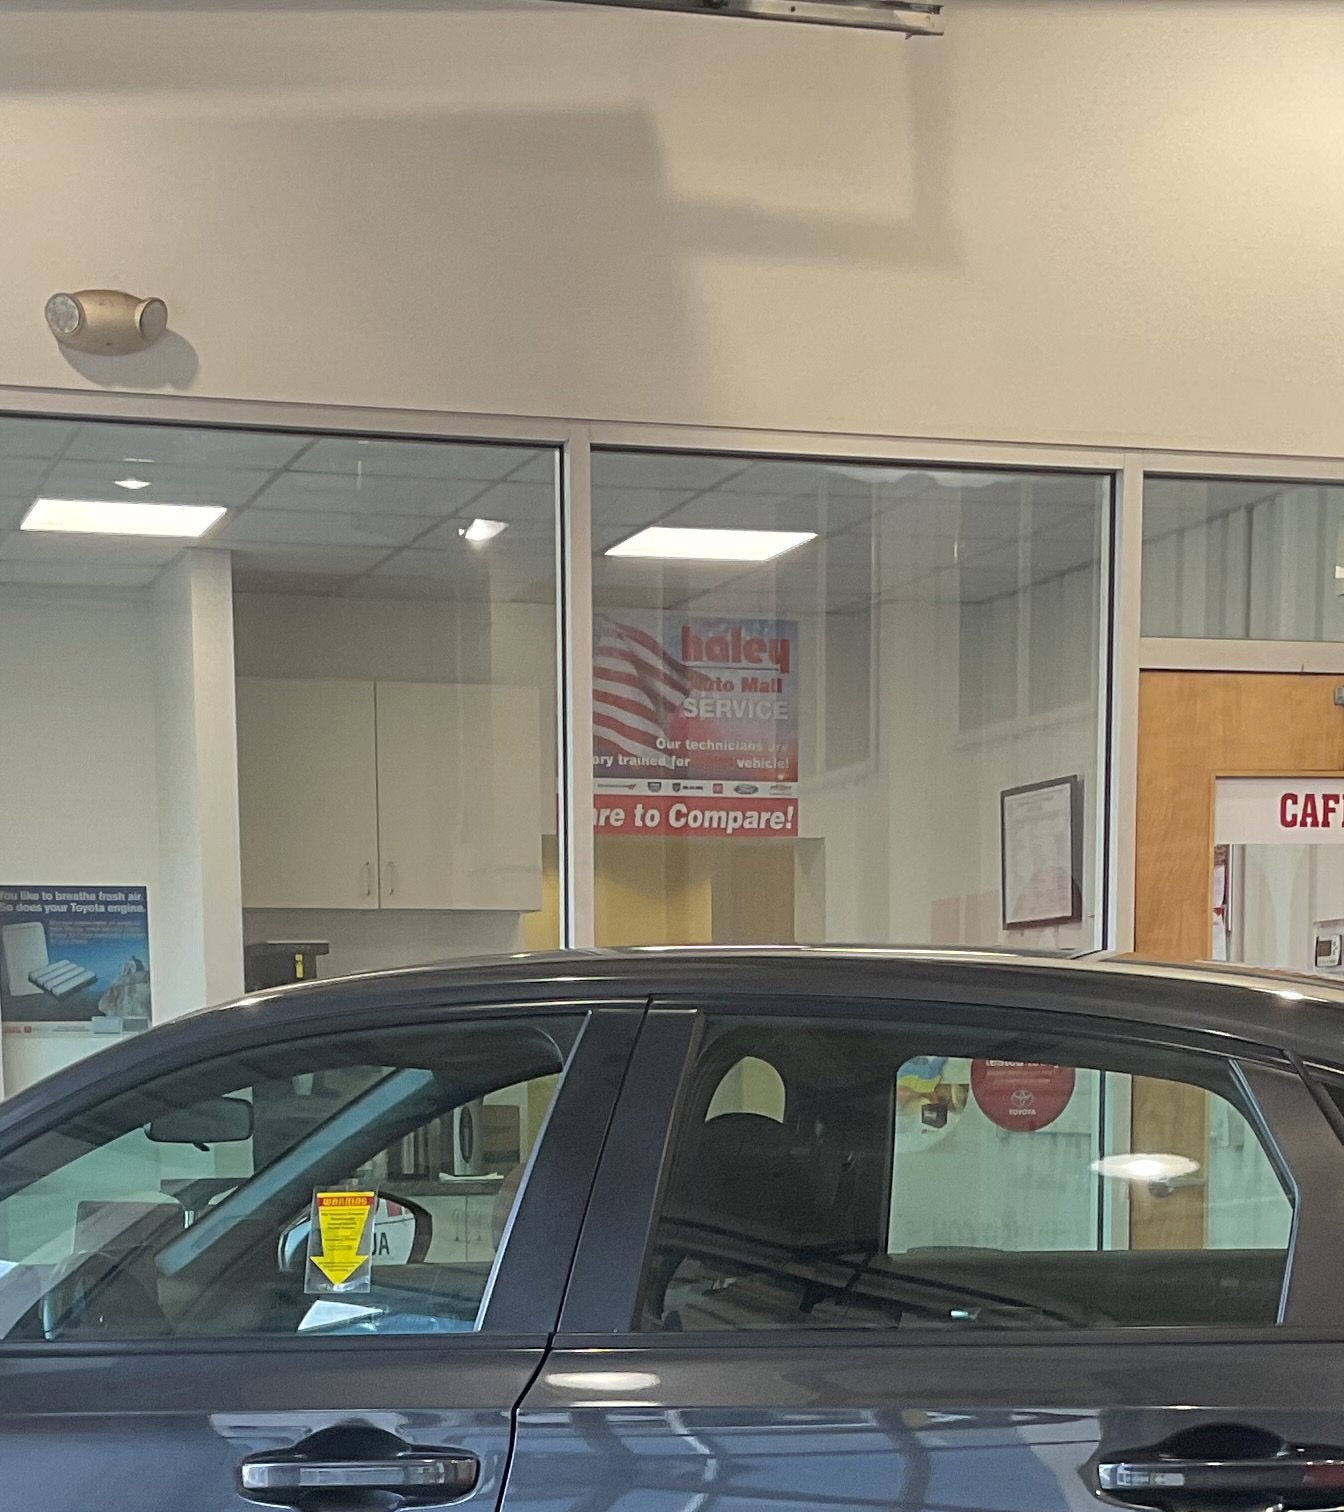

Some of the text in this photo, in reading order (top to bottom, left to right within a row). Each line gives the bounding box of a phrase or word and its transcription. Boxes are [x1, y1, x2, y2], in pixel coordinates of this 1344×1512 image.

[682, 624, 790, 674] haley
[741, 677, 783, 694] Mall
[683, 698, 788, 720] SERVICE
[656, 737, 681, 750] Our
[686, 737, 763, 751] technicians
[618, 754, 666, 767] trained
[672, 755, 691, 770] for
[634, 803, 661, 827] to
[668, 802, 795, 835] Compare!
[20, 890, 40, 901] like
[41, 891, 53, 901] to
[55, 891, 97, 901] breathe
[98, 890, 125, 901] fresh
[0, 902, 14, 912] So
[16, 902, 42, 912] does
[44, 904, 68, 914] your
[70, 902, 105, 914] Toyota
[1008, 1108, 1037, 1117] TOYOTA
[322, 1197, 368, 1207] WARNING
